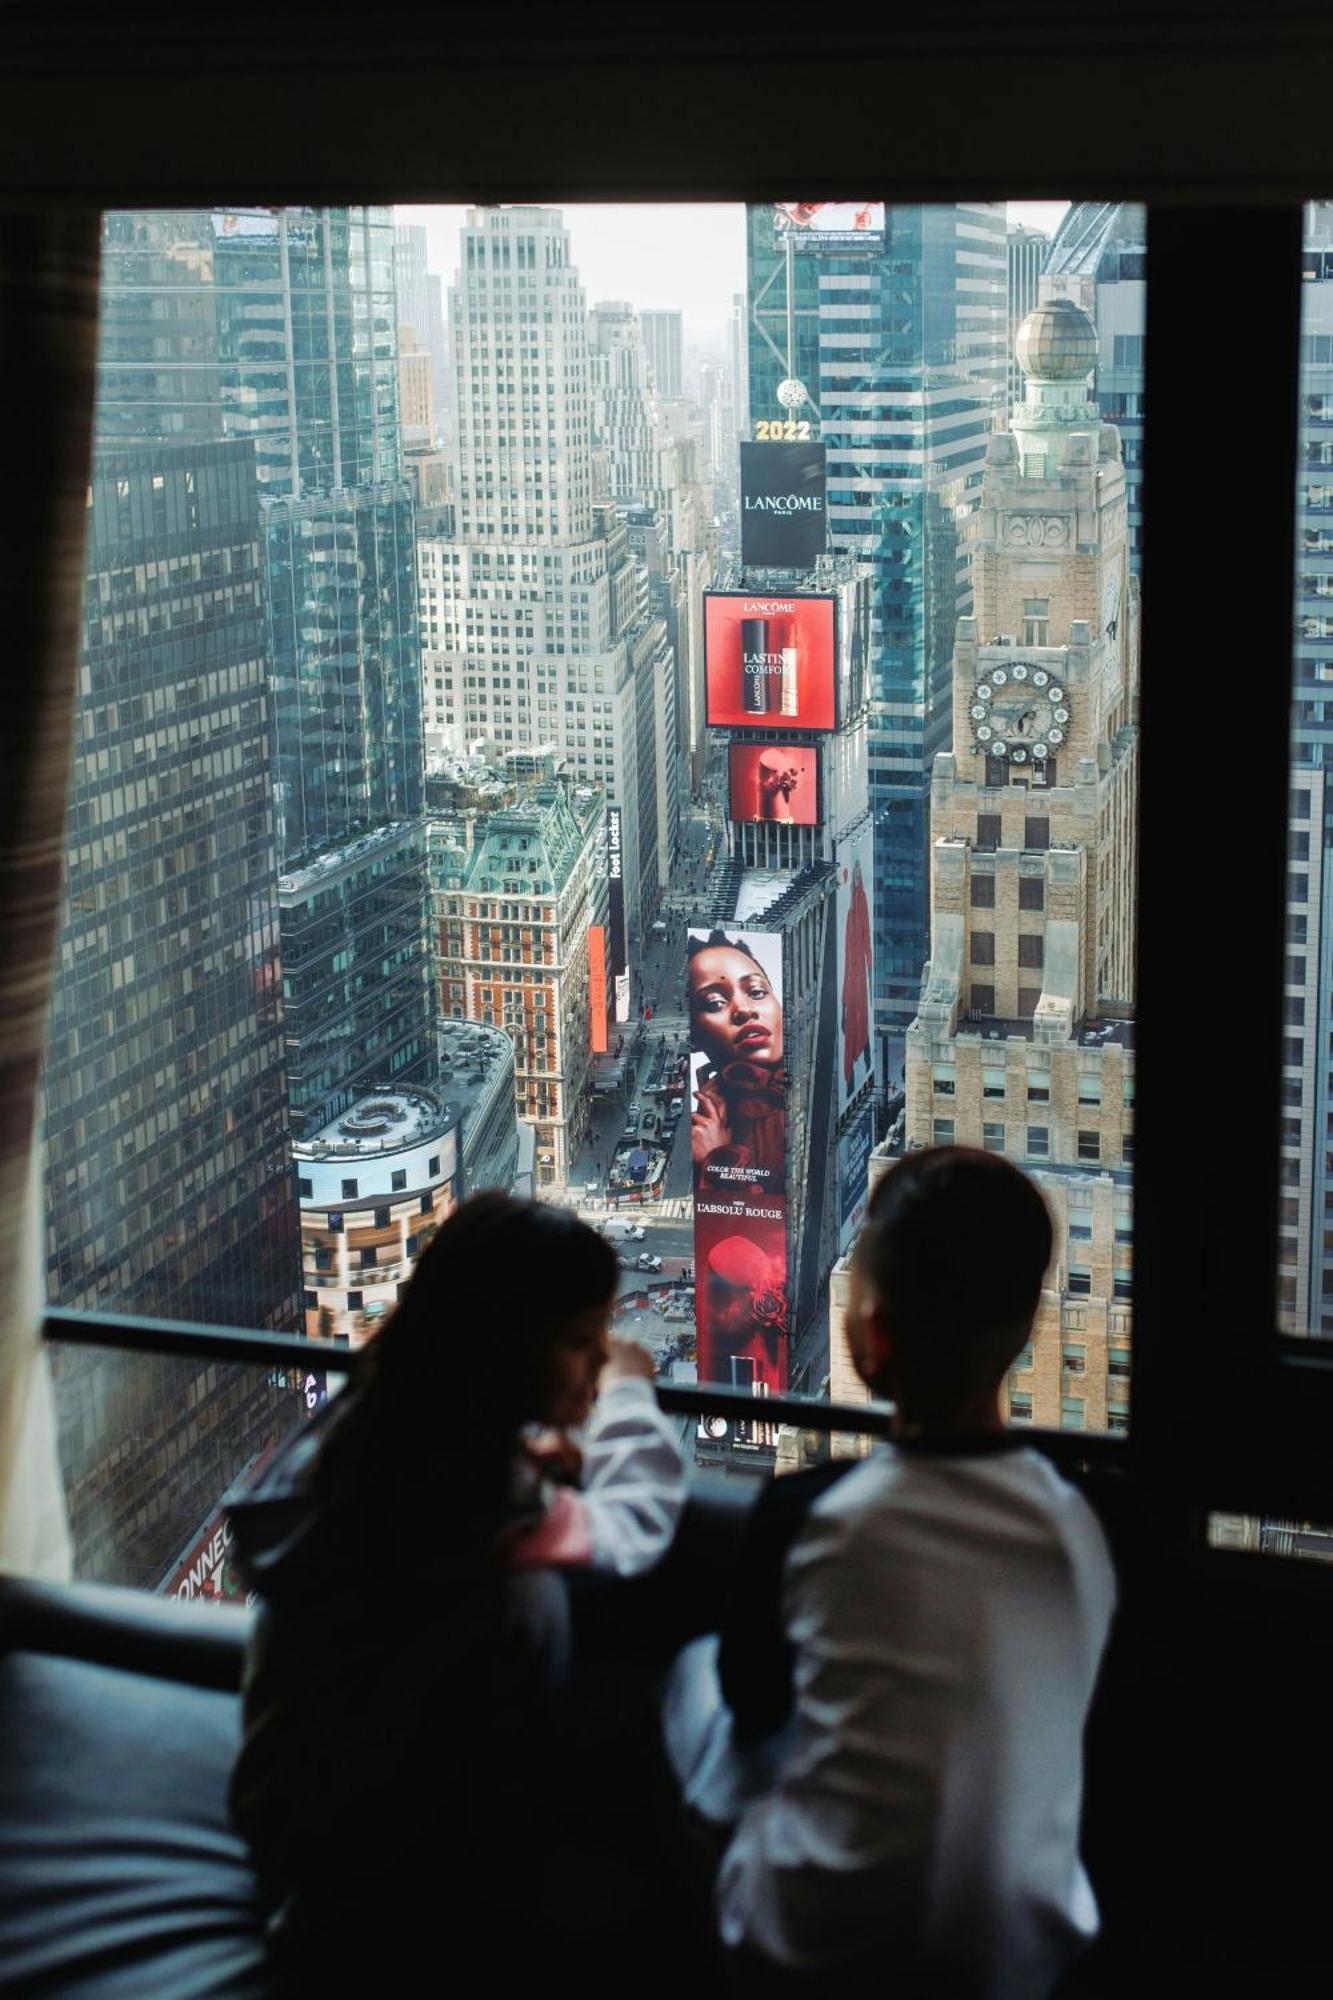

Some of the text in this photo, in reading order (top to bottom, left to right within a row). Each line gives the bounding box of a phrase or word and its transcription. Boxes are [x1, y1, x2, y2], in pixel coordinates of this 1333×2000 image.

[757, 420, 810, 440] 2022
[745, 495, 822, 510] LANCÔME
[609, 811, 621, 878] Foot Locker
[719, 1173, 757, 1182] BEAUTIFUL
[745, 1168, 770, 1177] WORLD
[696, 1203, 743, 1215] L'ABSOLU
[745, 1207, 783, 1219] ROUGE
